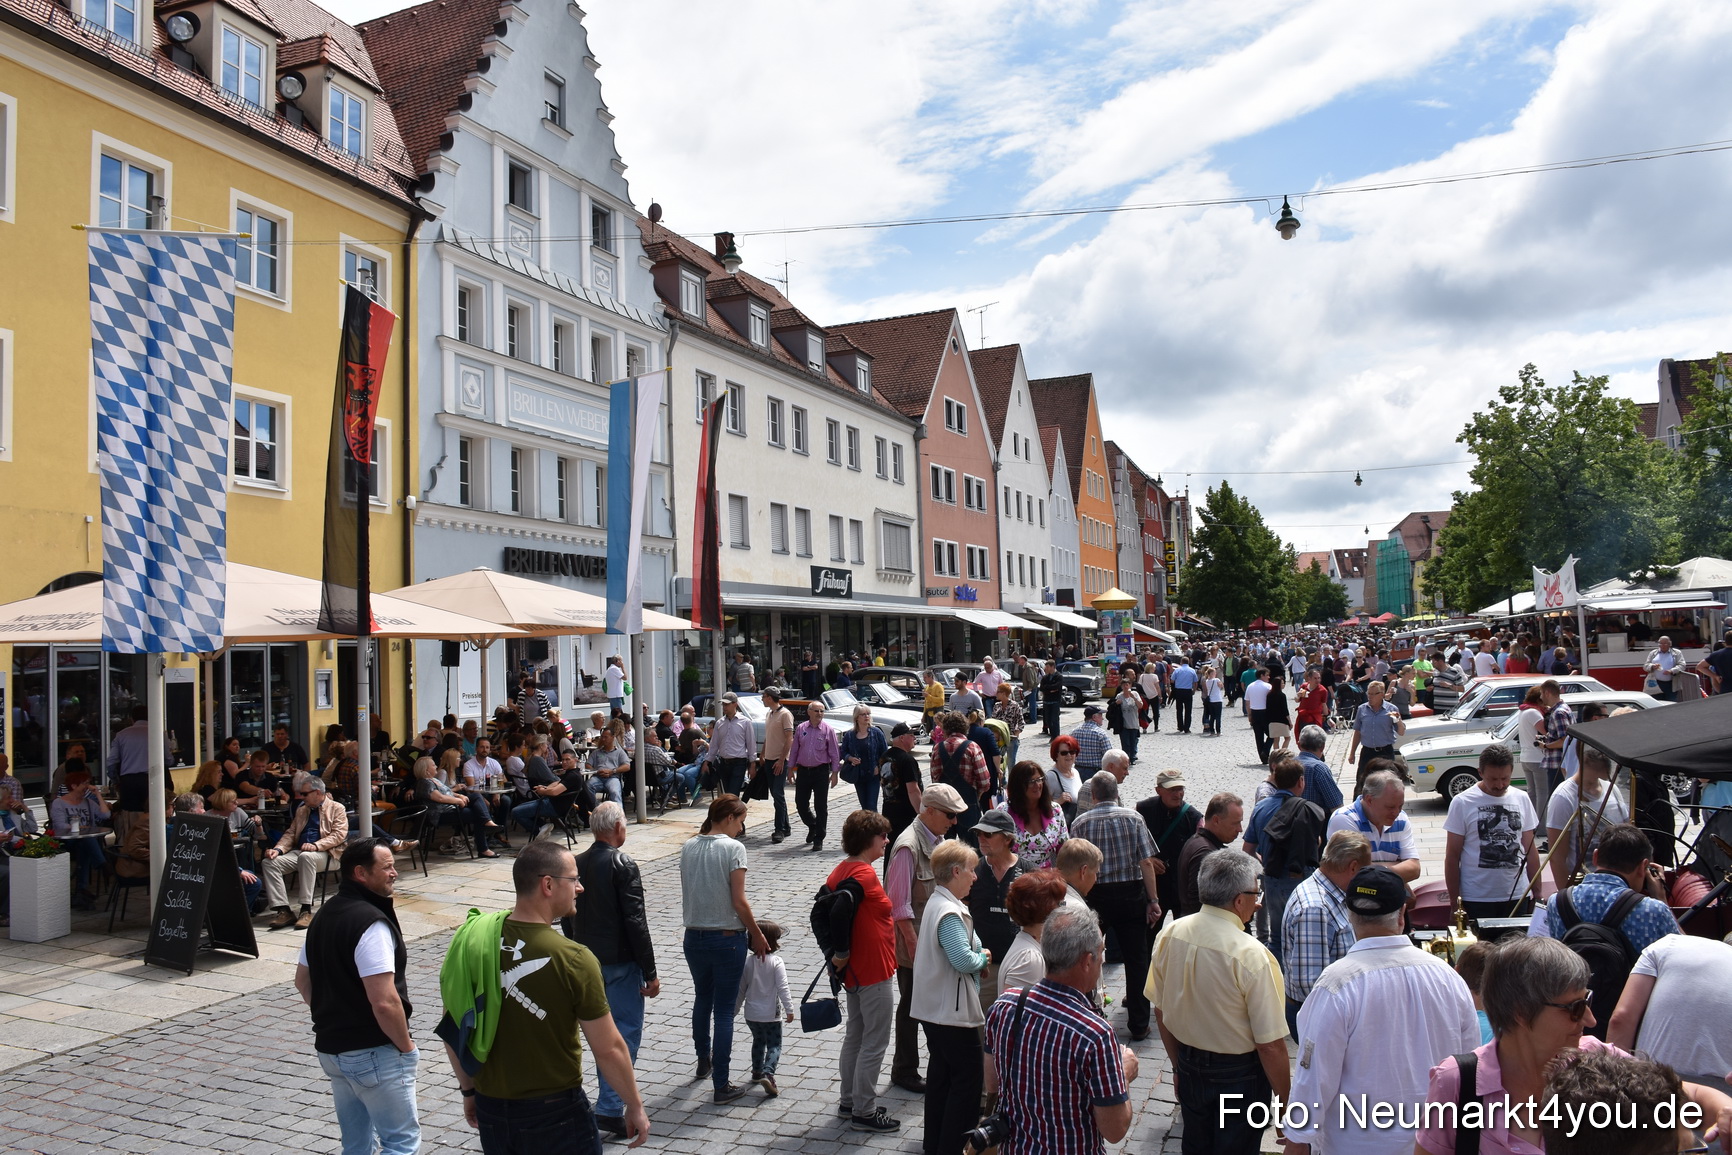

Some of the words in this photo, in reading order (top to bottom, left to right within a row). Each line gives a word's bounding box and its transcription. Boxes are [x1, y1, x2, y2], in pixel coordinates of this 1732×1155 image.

[513, 390, 564, 423] BRILLEN
[566, 405, 609, 434] WEBER
[504, 546, 569, 576] BRILLEN
[1165, 542, 1176, 595] HOTEL
[391, 642, 400, 652] 24
[179, 823, 209, 841] Original
[164, 890, 192, 910] Salate
[158, 918, 188, 941] Baguettes
